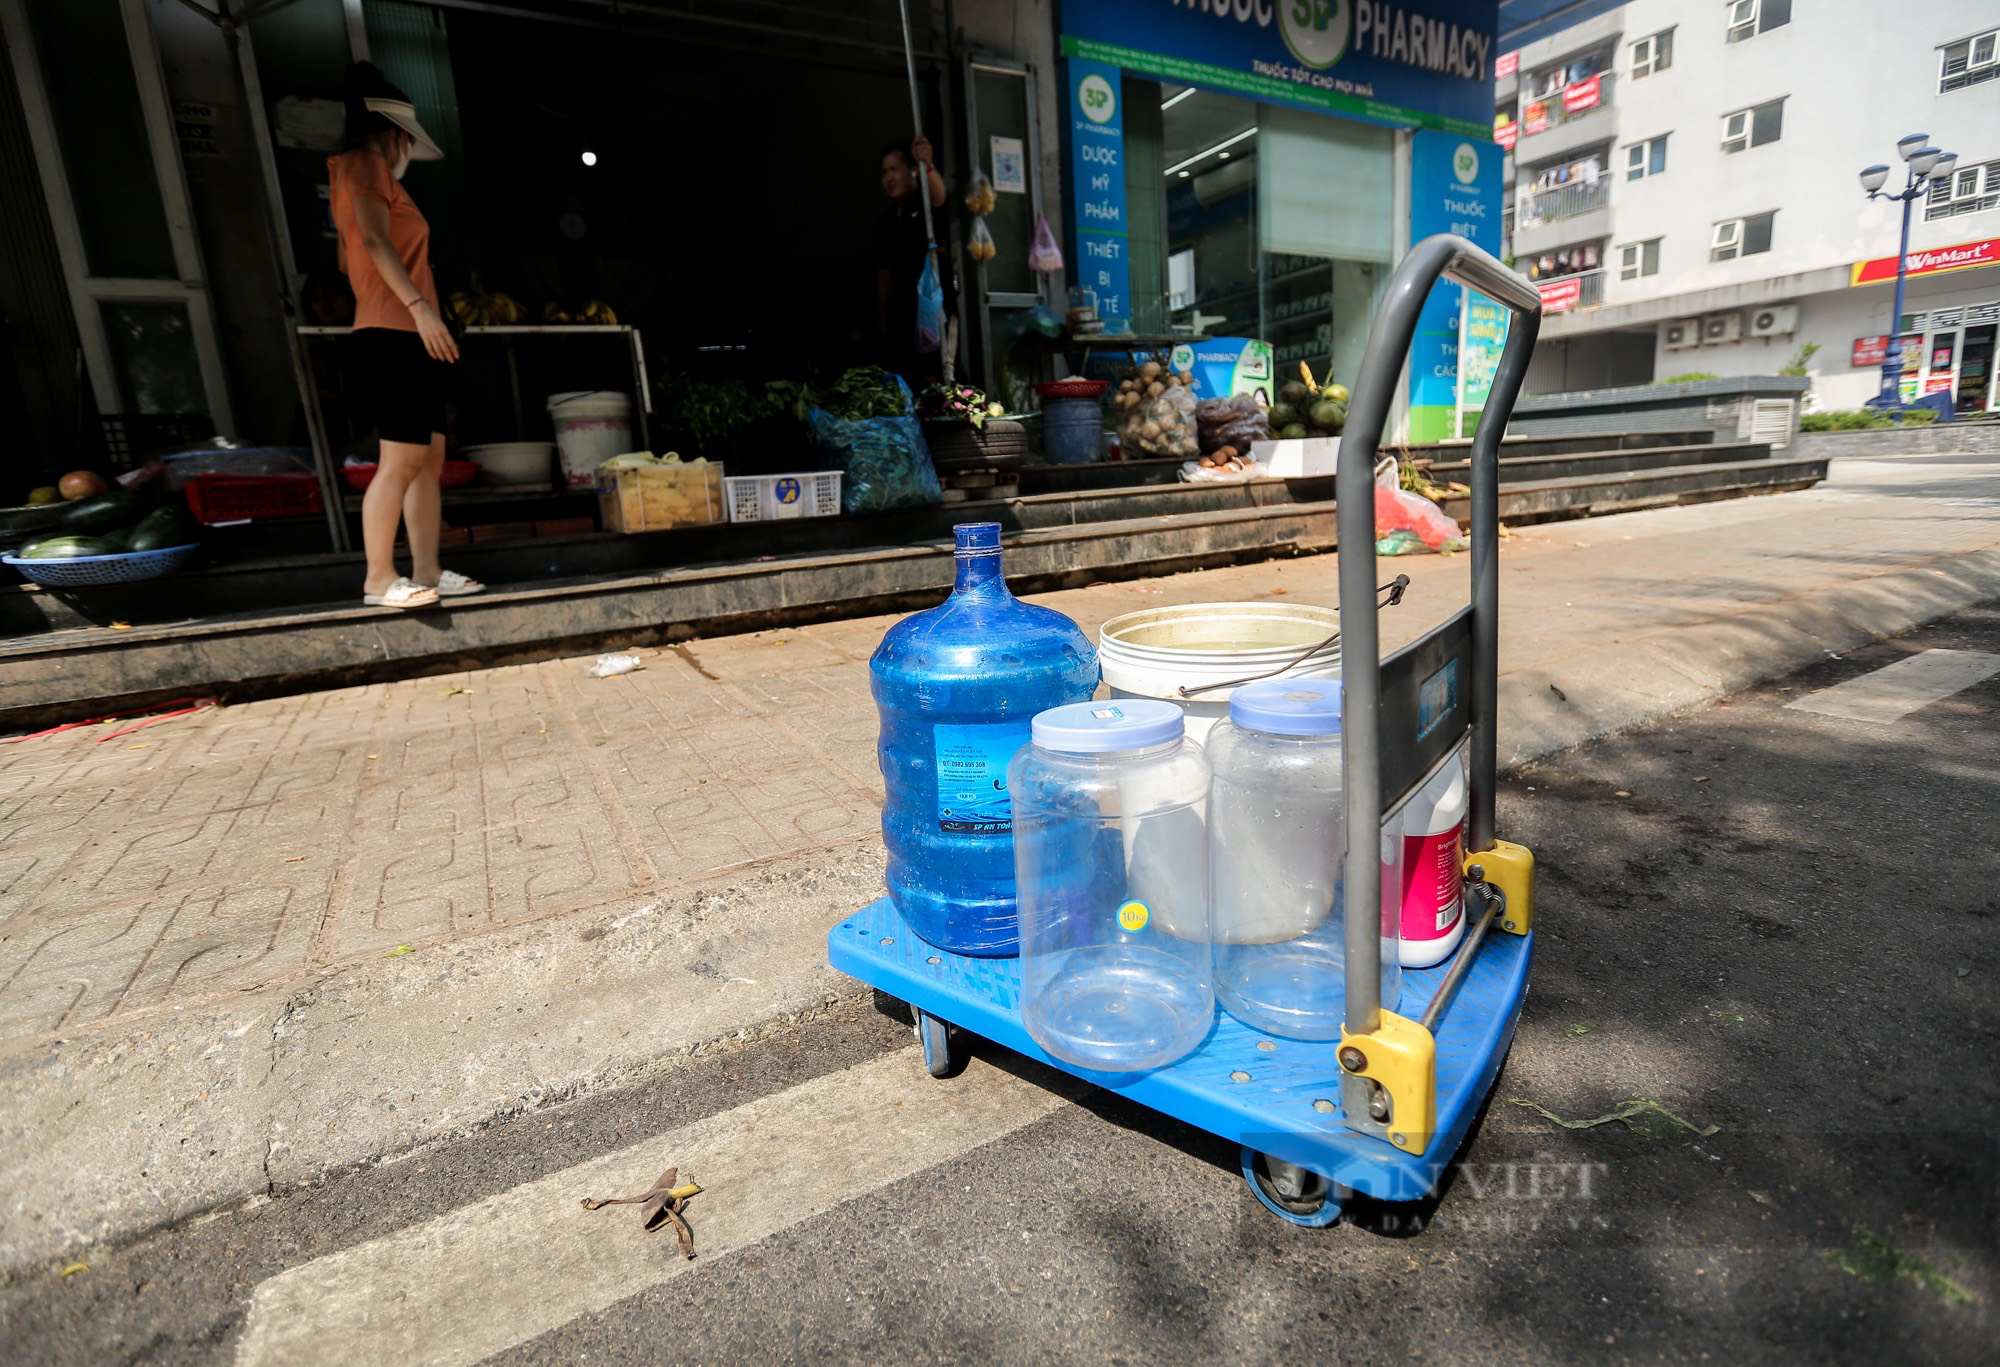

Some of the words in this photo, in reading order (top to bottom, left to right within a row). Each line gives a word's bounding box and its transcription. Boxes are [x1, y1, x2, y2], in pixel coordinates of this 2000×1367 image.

[1356, 0, 1490, 82] PHARMACY
[1252, 59, 1289, 79] THUỐC
[1291, 65, 1311, 83] TỐT
[1312, 73, 1334, 90] CHO
[1335, 79, 1354, 95] MỌI
[1355, 82, 1374, 97] NHÀ
[1085, 88, 1108, 108] 3P
[1443, 198, 1487, 217] THUỐC
[1086, 239, 1120, 259] THIẾT
[1099, 270, 1111, 288] BỊ
[1104, 294, 1119, 314] TẾ
[1177, 351, 1191, 363] 3P
[1198, 353, 1238, 363] PHARMACY
